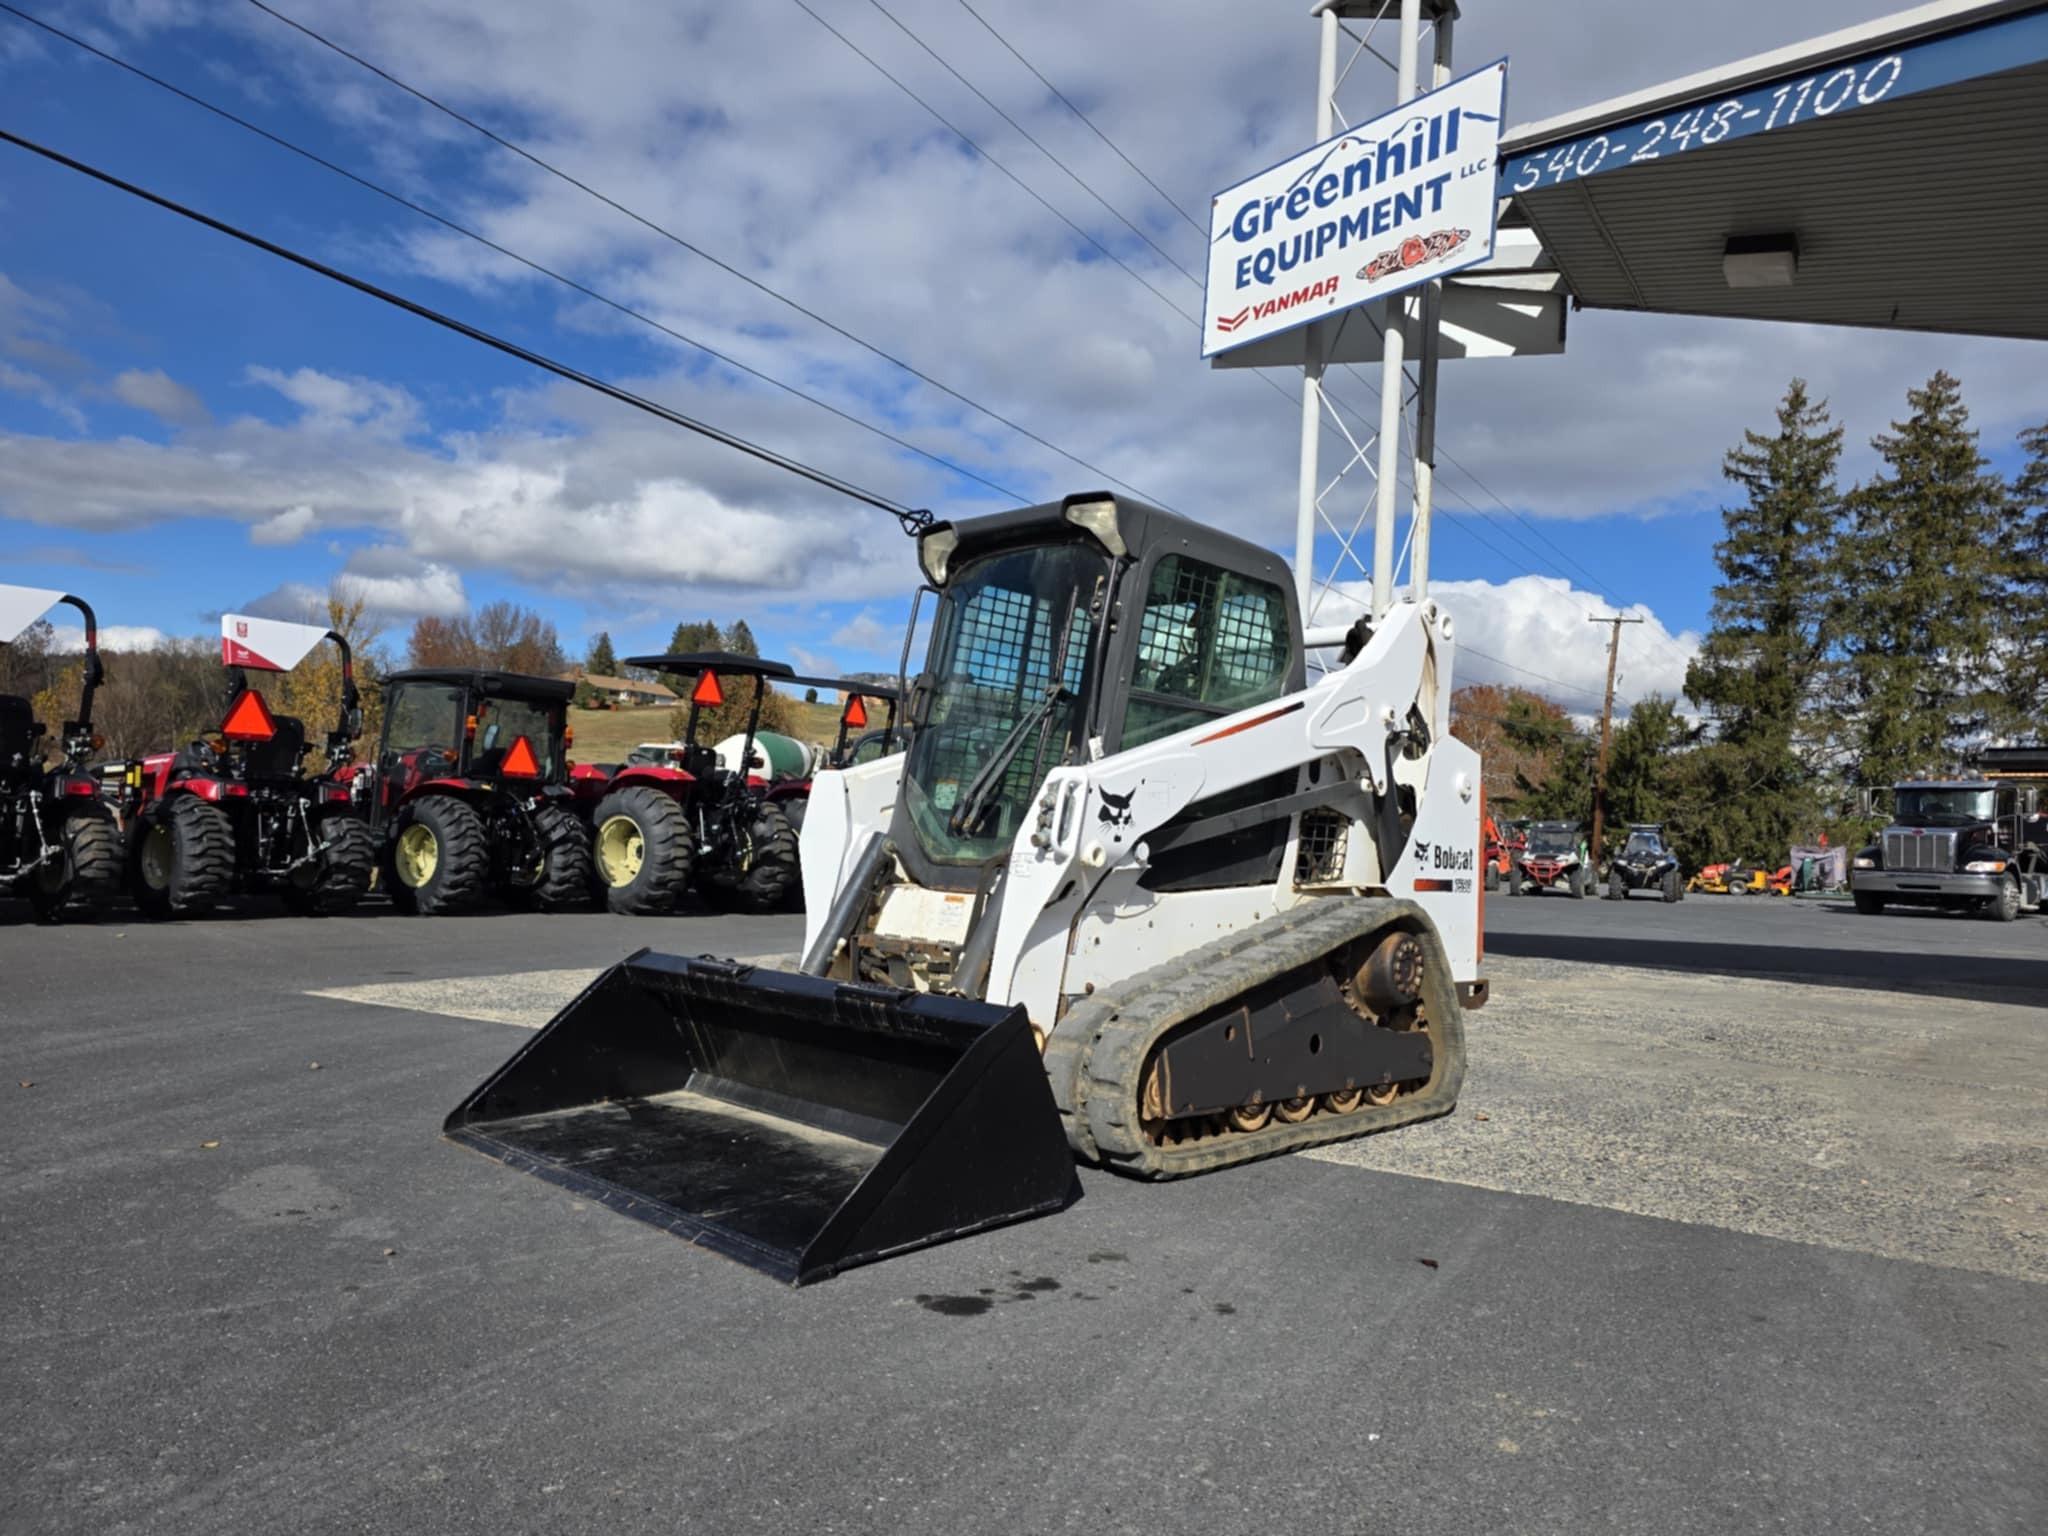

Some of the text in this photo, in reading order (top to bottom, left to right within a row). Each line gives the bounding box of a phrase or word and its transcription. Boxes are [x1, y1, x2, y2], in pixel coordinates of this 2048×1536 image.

[1232, 107, 1460, 243] Greenhill
[1513, 56, 1902, 193] 540-248-1100
[1235, 172, 1452, 290] EQUIPMENT
[1460, 158, 1487, 179] LLC
[1252, 276, 1340, 320] YANMAR
[1434, 845, 1473, 870] Bobcat
